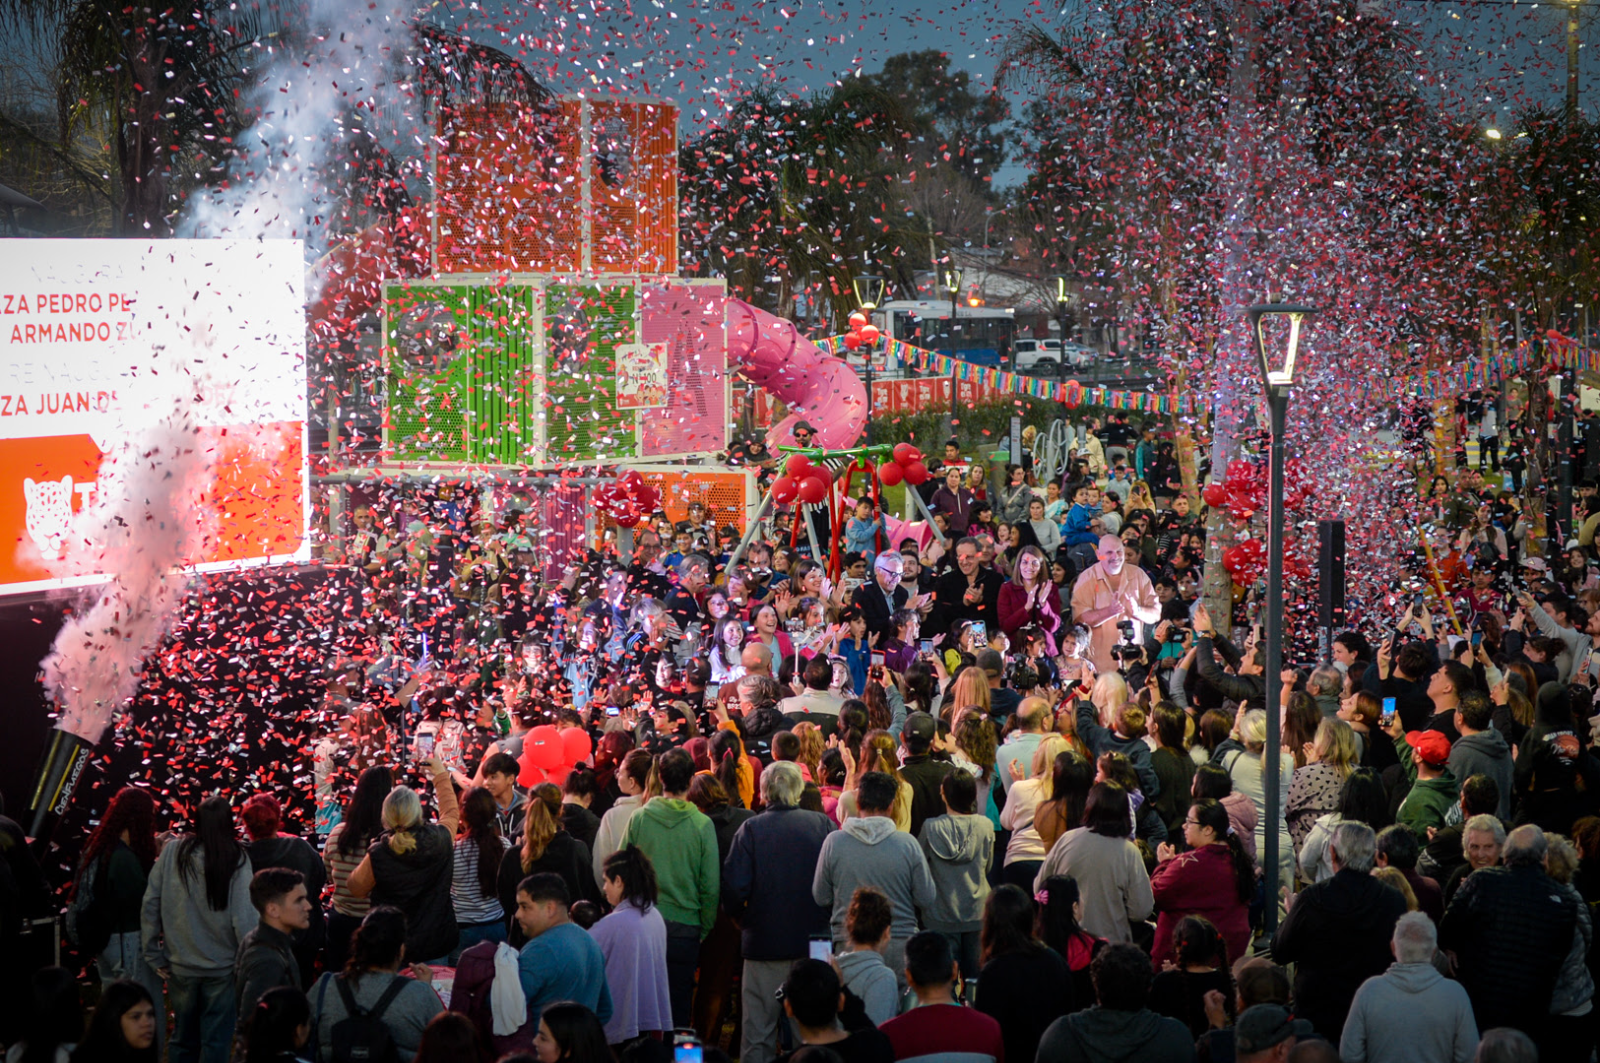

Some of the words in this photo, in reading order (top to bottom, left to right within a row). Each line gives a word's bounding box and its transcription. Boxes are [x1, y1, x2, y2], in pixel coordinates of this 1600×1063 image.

[37, 292, 102, 314] PEDRO
[10, 321, 110, 344] ARMANDO
[36, 391, 90, 414] JUAN
